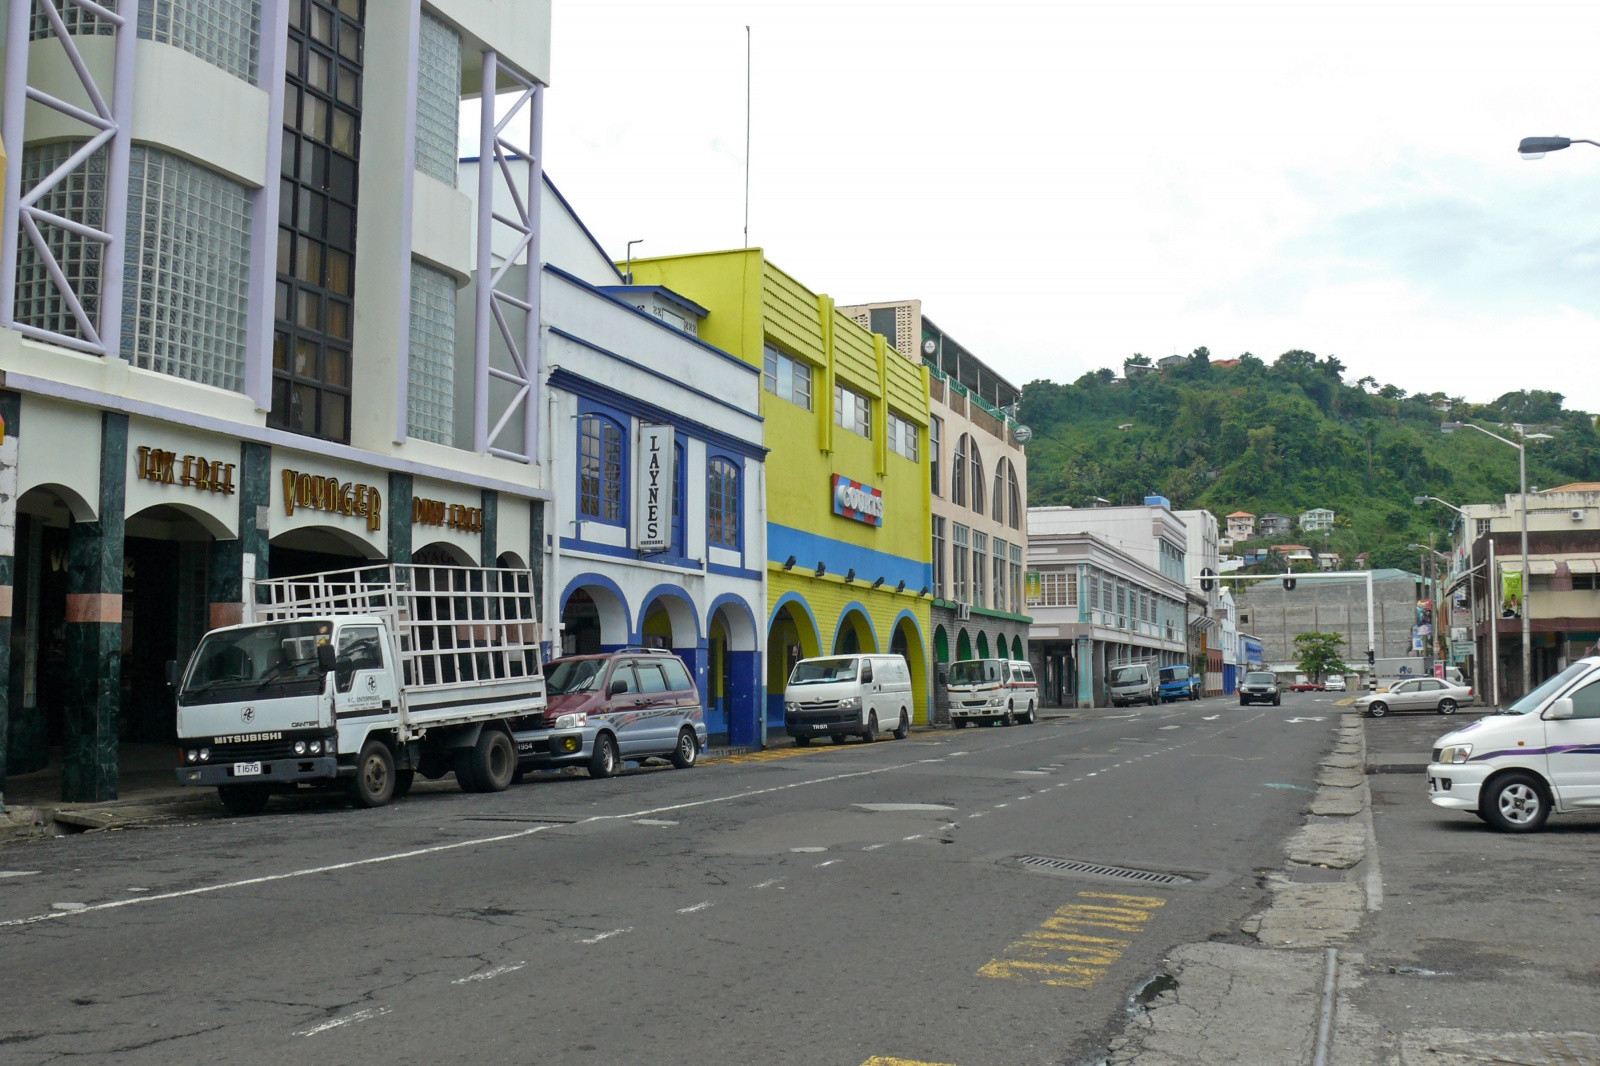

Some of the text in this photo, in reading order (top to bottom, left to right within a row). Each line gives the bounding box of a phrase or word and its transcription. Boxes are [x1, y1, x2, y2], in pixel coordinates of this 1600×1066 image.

[138, 446, 236, 496] TAX FREE
[647, 435, 660, 539] LAYNES
[412, 496, 483, 534] DUTY FREE
[838, 485, 883, 518] COURTS
[214, 732, 282, 744] MITSUBISHI
